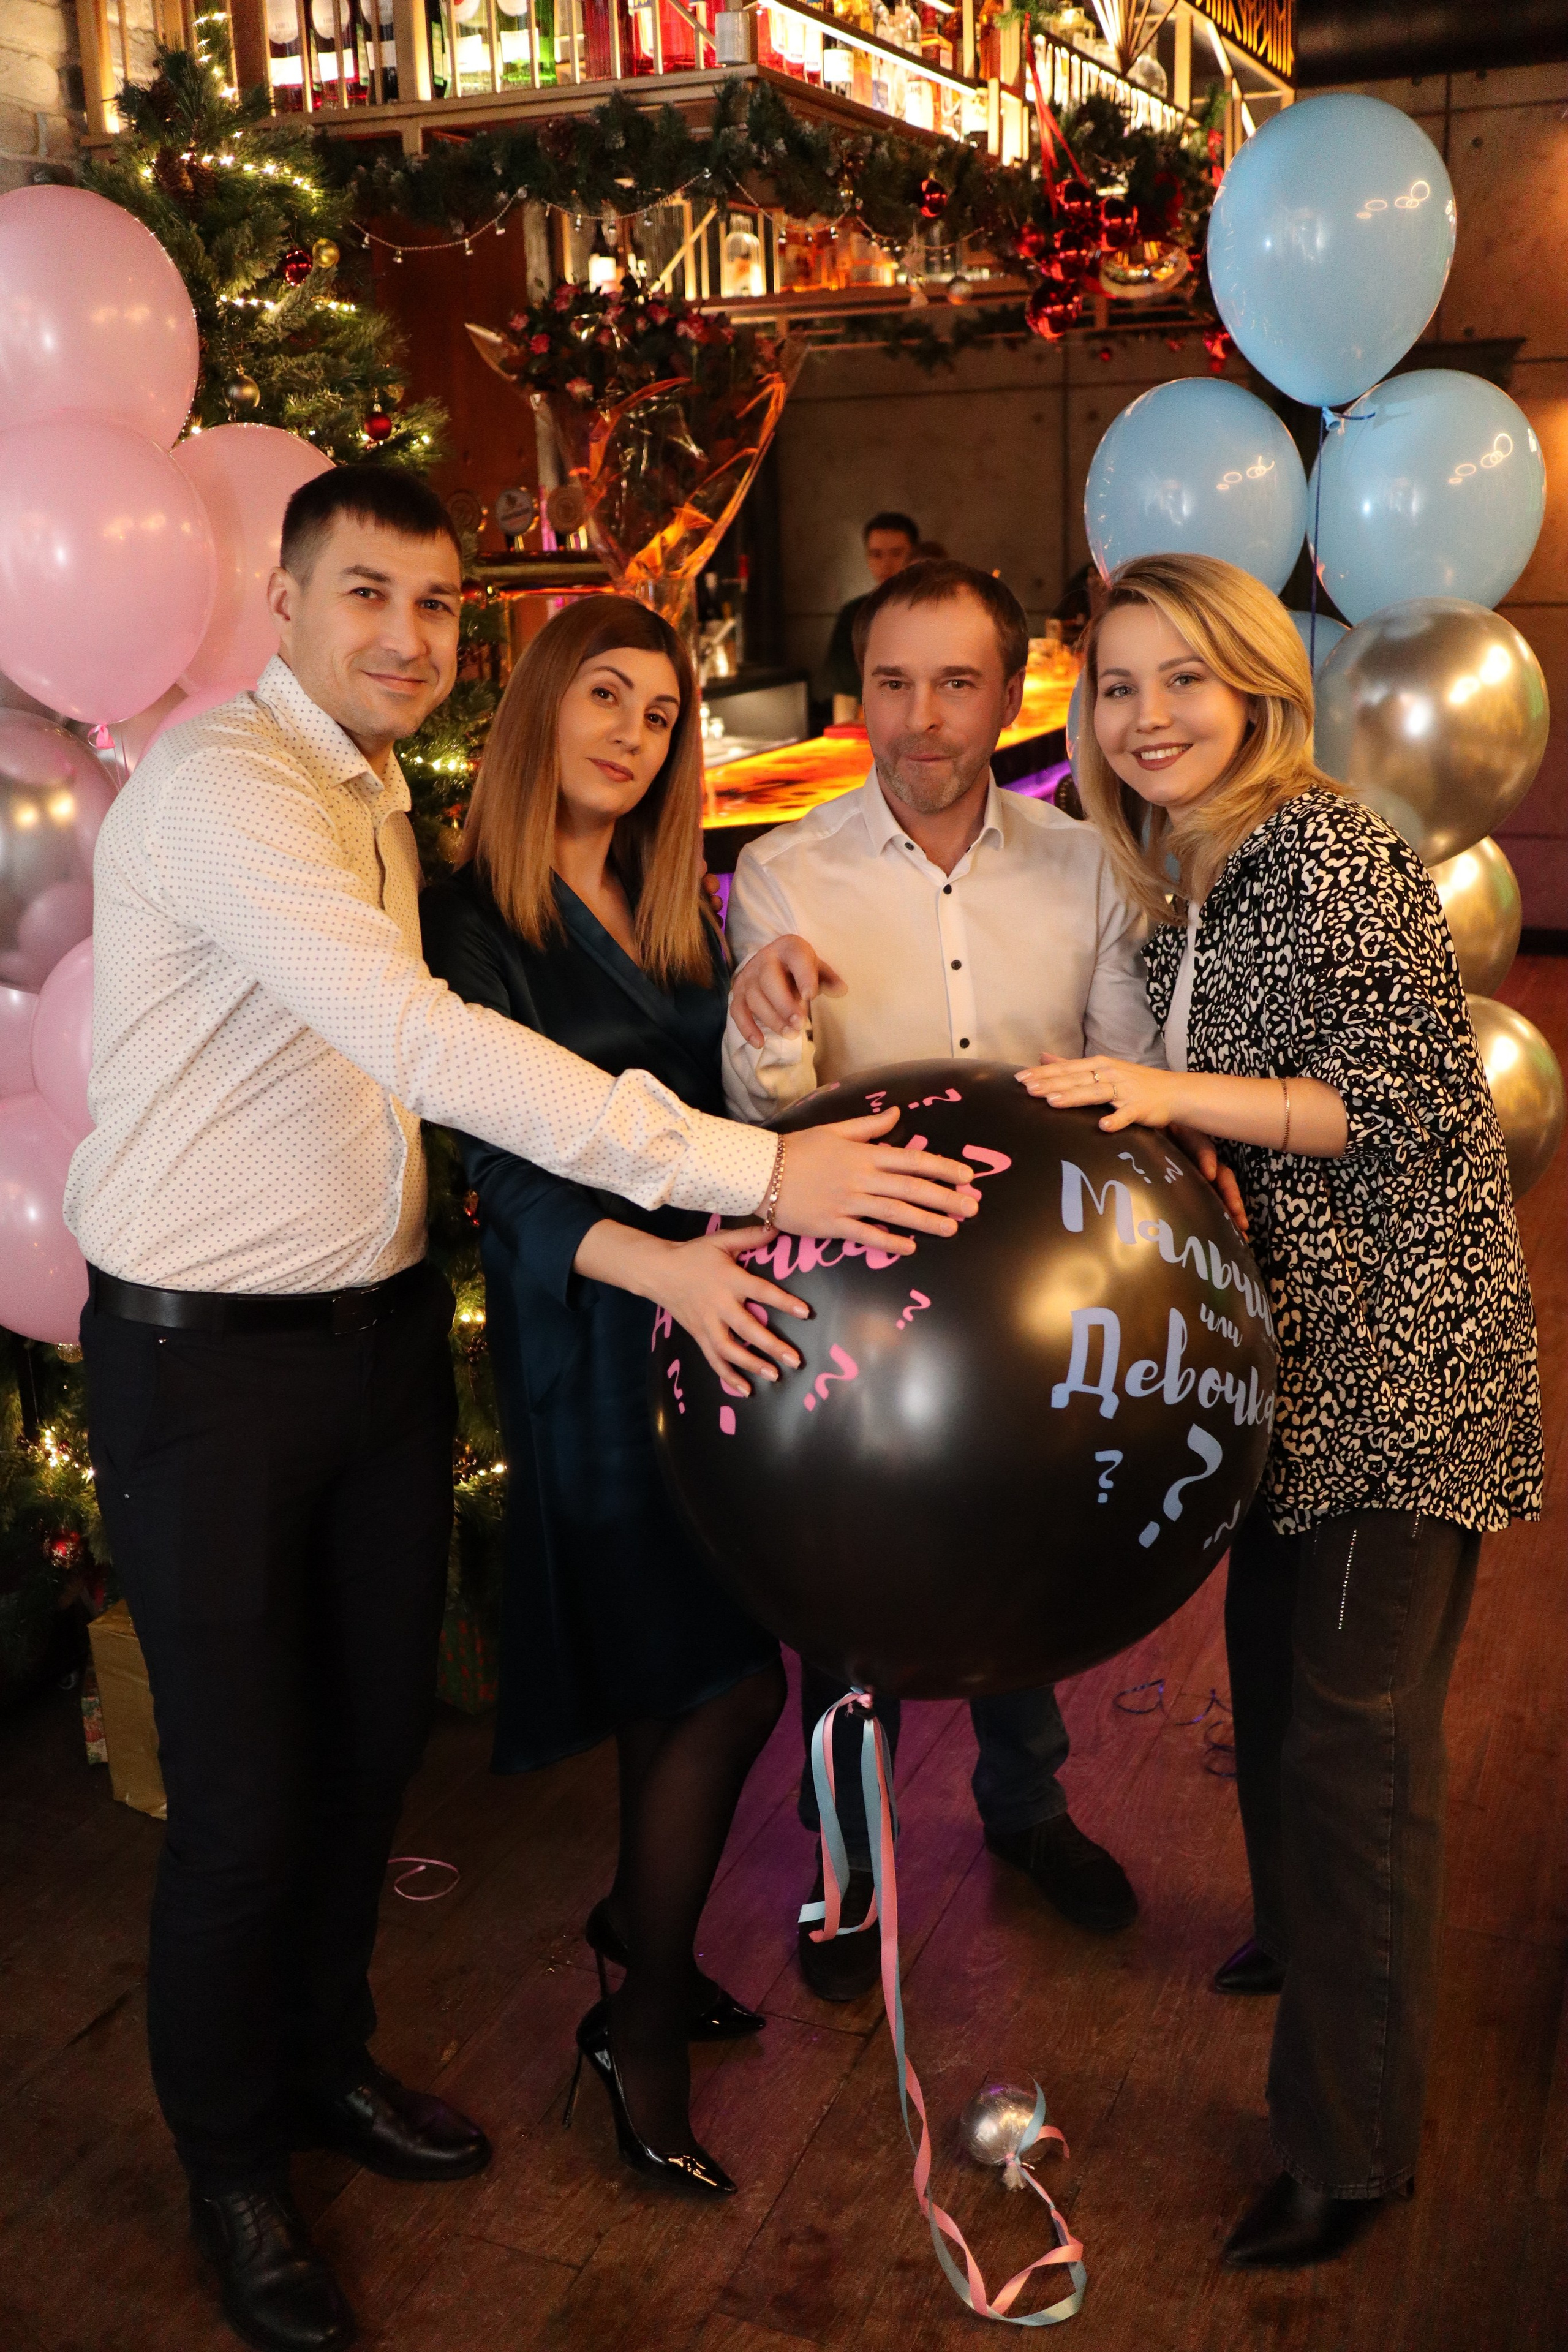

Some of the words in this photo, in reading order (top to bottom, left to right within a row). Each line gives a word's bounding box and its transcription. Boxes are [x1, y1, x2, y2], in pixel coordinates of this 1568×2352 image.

[1061, 1160, 1276, 1343] Мальчи
[1050, 1307, 1274, 1434] Девочка
[1200, 1303, 1243, 1348] или
